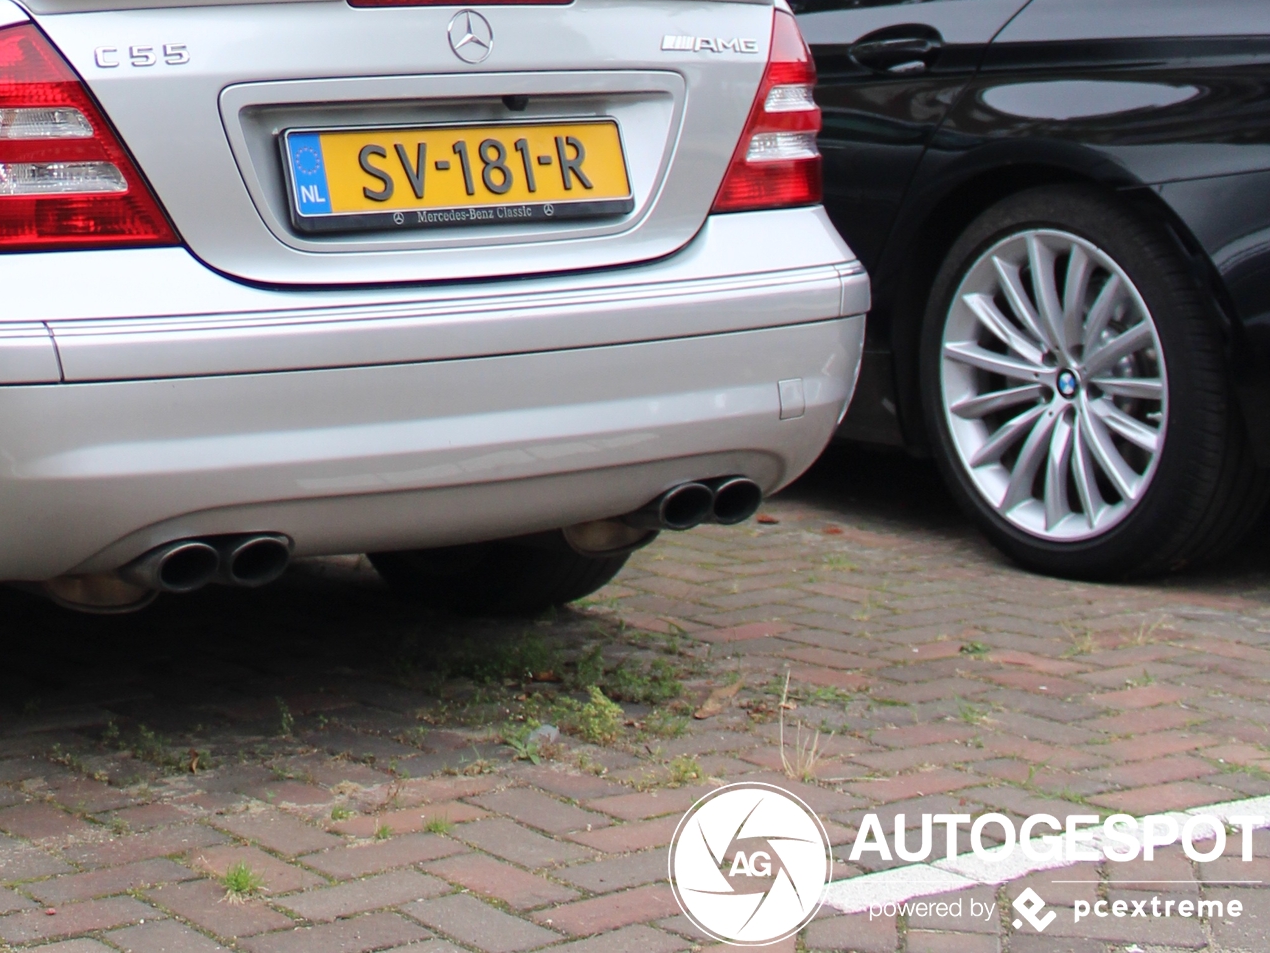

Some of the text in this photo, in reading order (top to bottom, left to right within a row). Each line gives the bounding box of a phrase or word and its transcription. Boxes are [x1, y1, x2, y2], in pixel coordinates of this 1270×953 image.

[694, 37, 759, 53] AMG
[358, 135, 593, 202] SV-181-R
[301, 184, 326, 203] NL
[417, 205, 532, 223] Mercedes-Benz Classic
